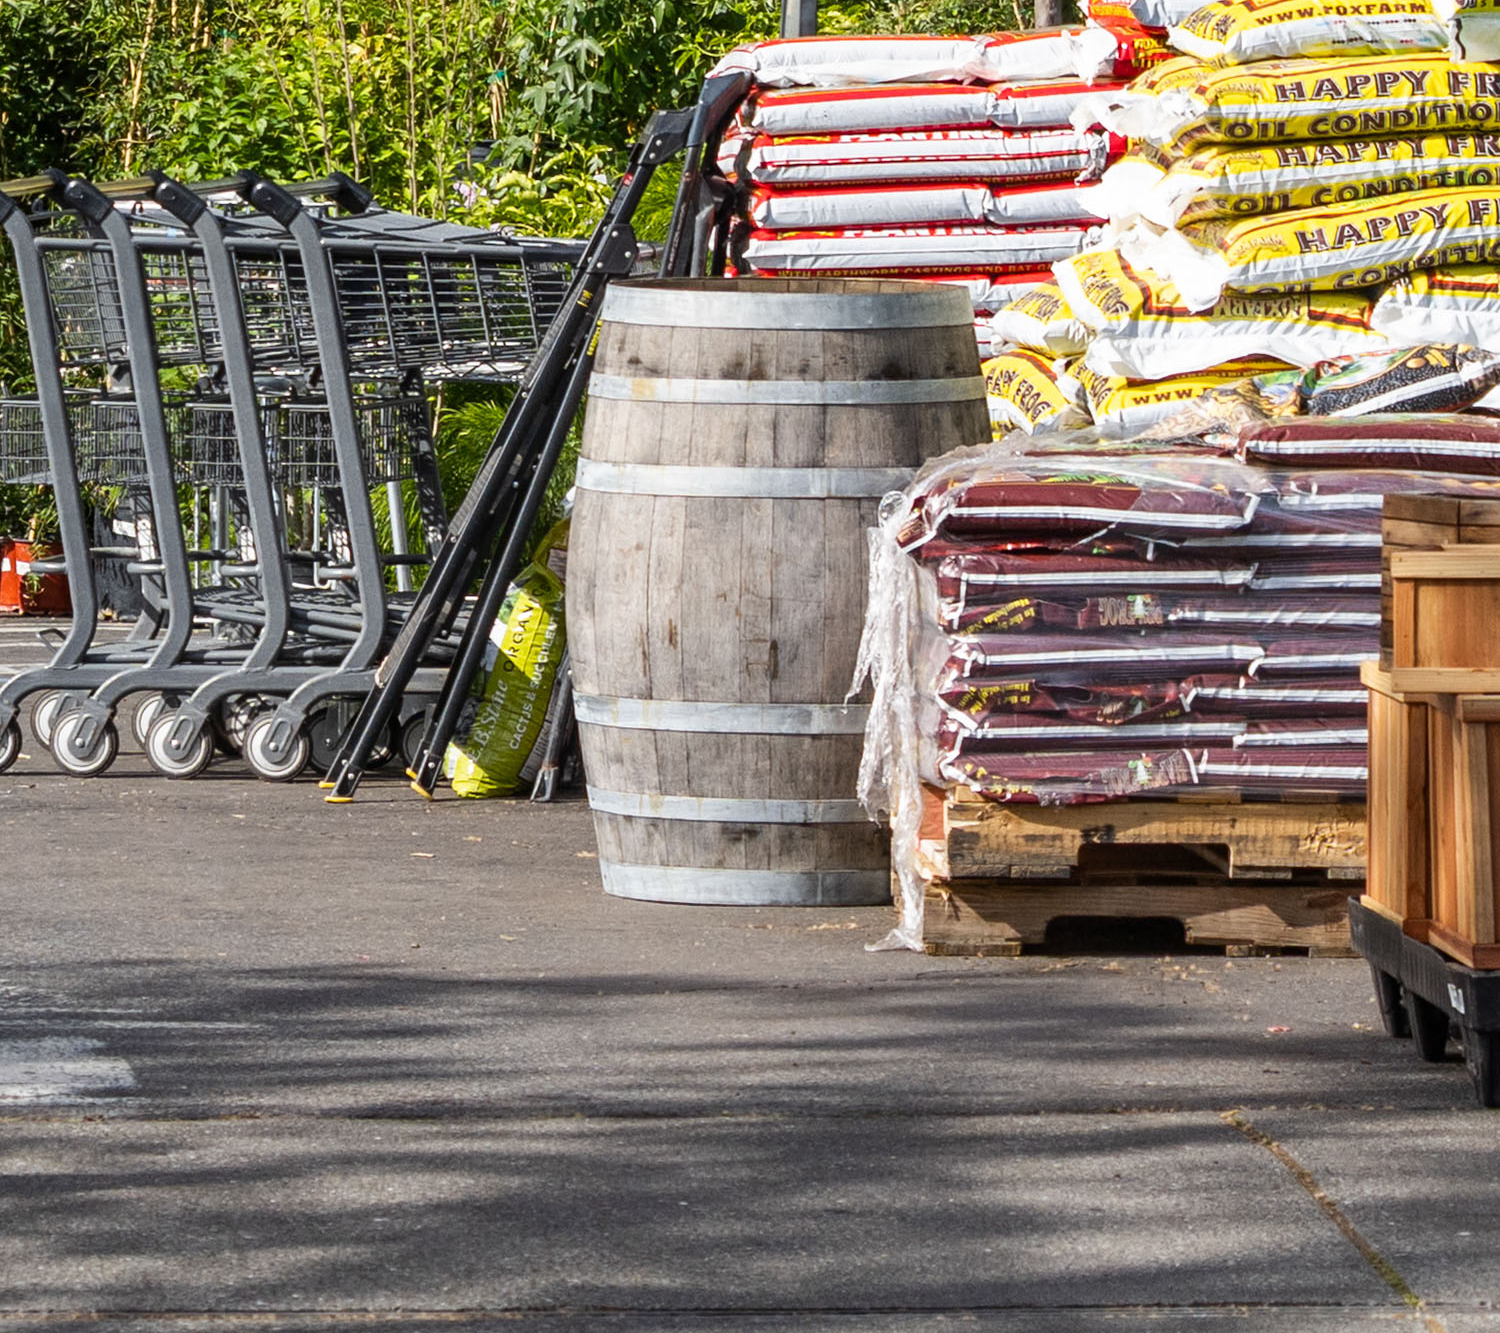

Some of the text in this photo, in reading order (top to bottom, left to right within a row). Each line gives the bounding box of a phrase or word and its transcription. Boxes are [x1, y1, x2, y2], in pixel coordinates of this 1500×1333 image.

[1274, 68, 1431, 103] HAPPY
[1278, 134, 1429, 168] HAPPY
[1294, 200, 1451, 254] HAPPY
